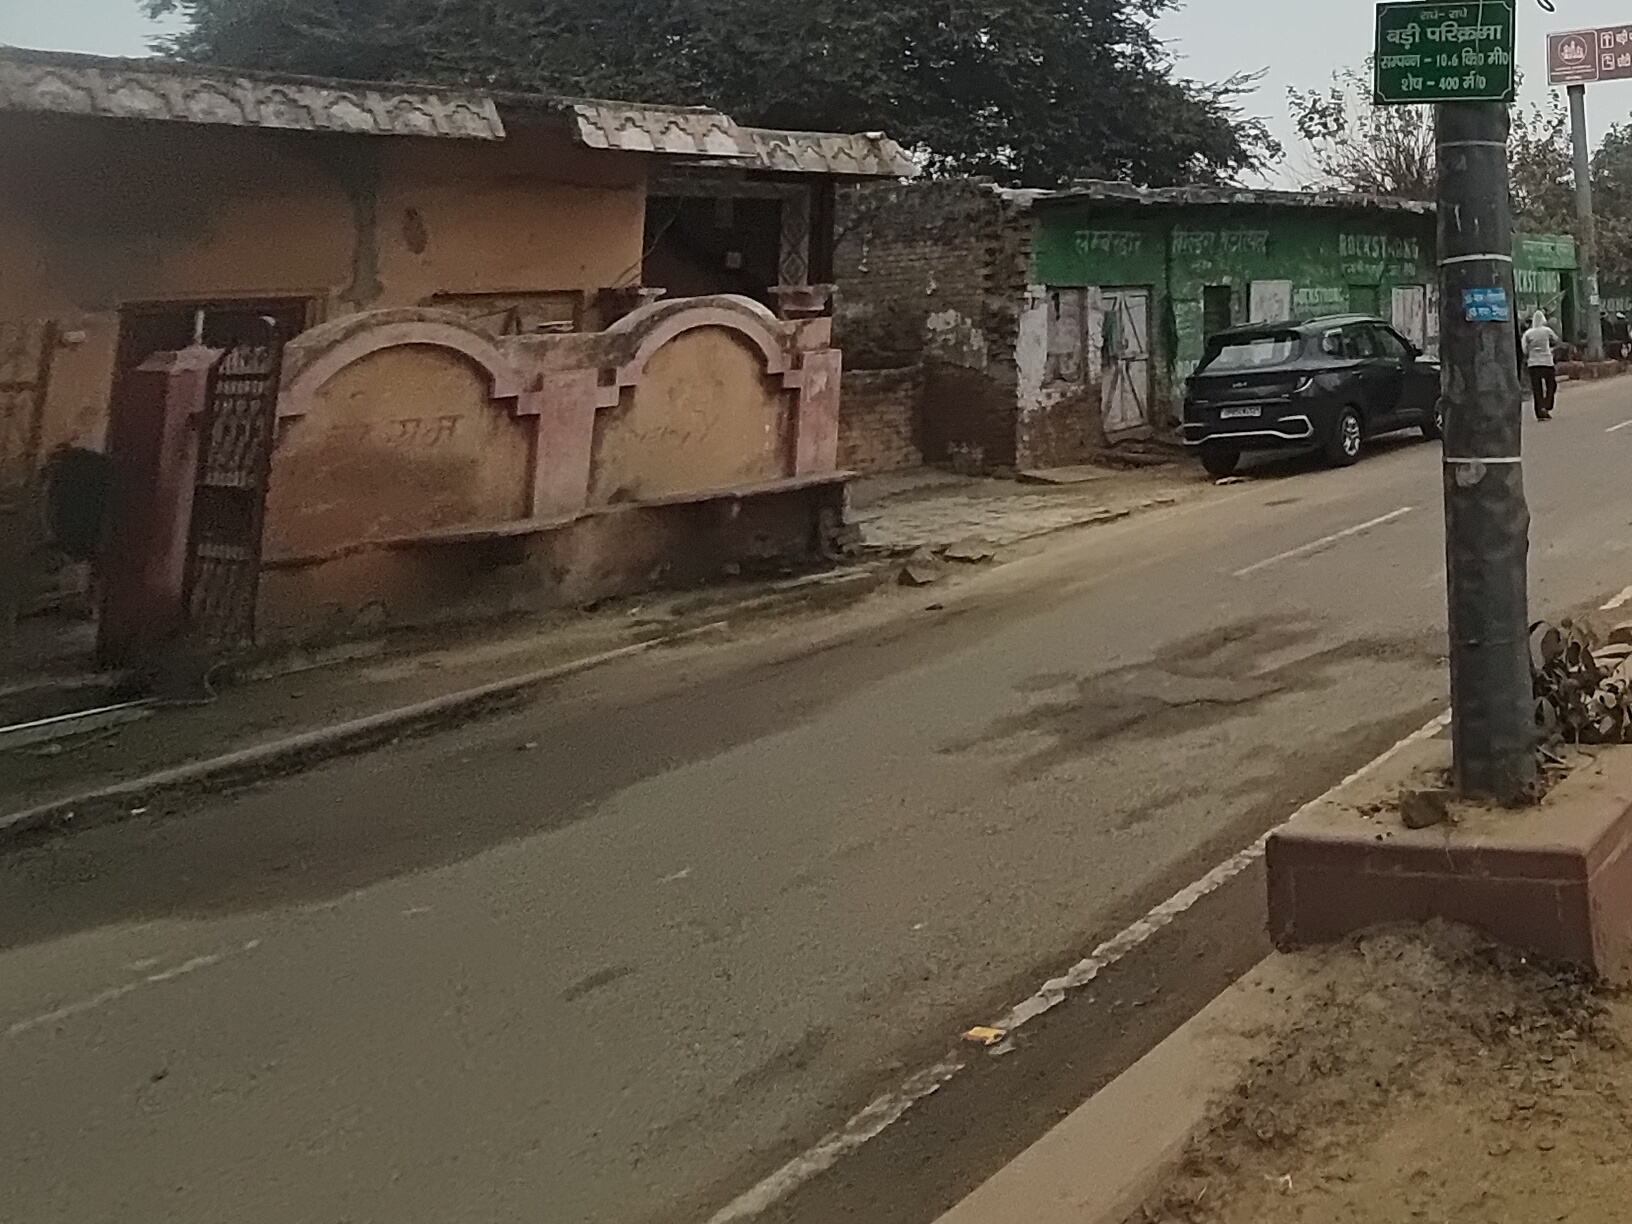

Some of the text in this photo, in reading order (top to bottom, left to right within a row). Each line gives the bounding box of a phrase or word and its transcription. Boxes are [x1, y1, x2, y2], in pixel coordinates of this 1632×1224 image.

[1386, 21, 1503, 49] बड़ी परिक्रमा
[1436, 54, 1459, 68] 10.6
[1439, 76, 1460, 90] 400
